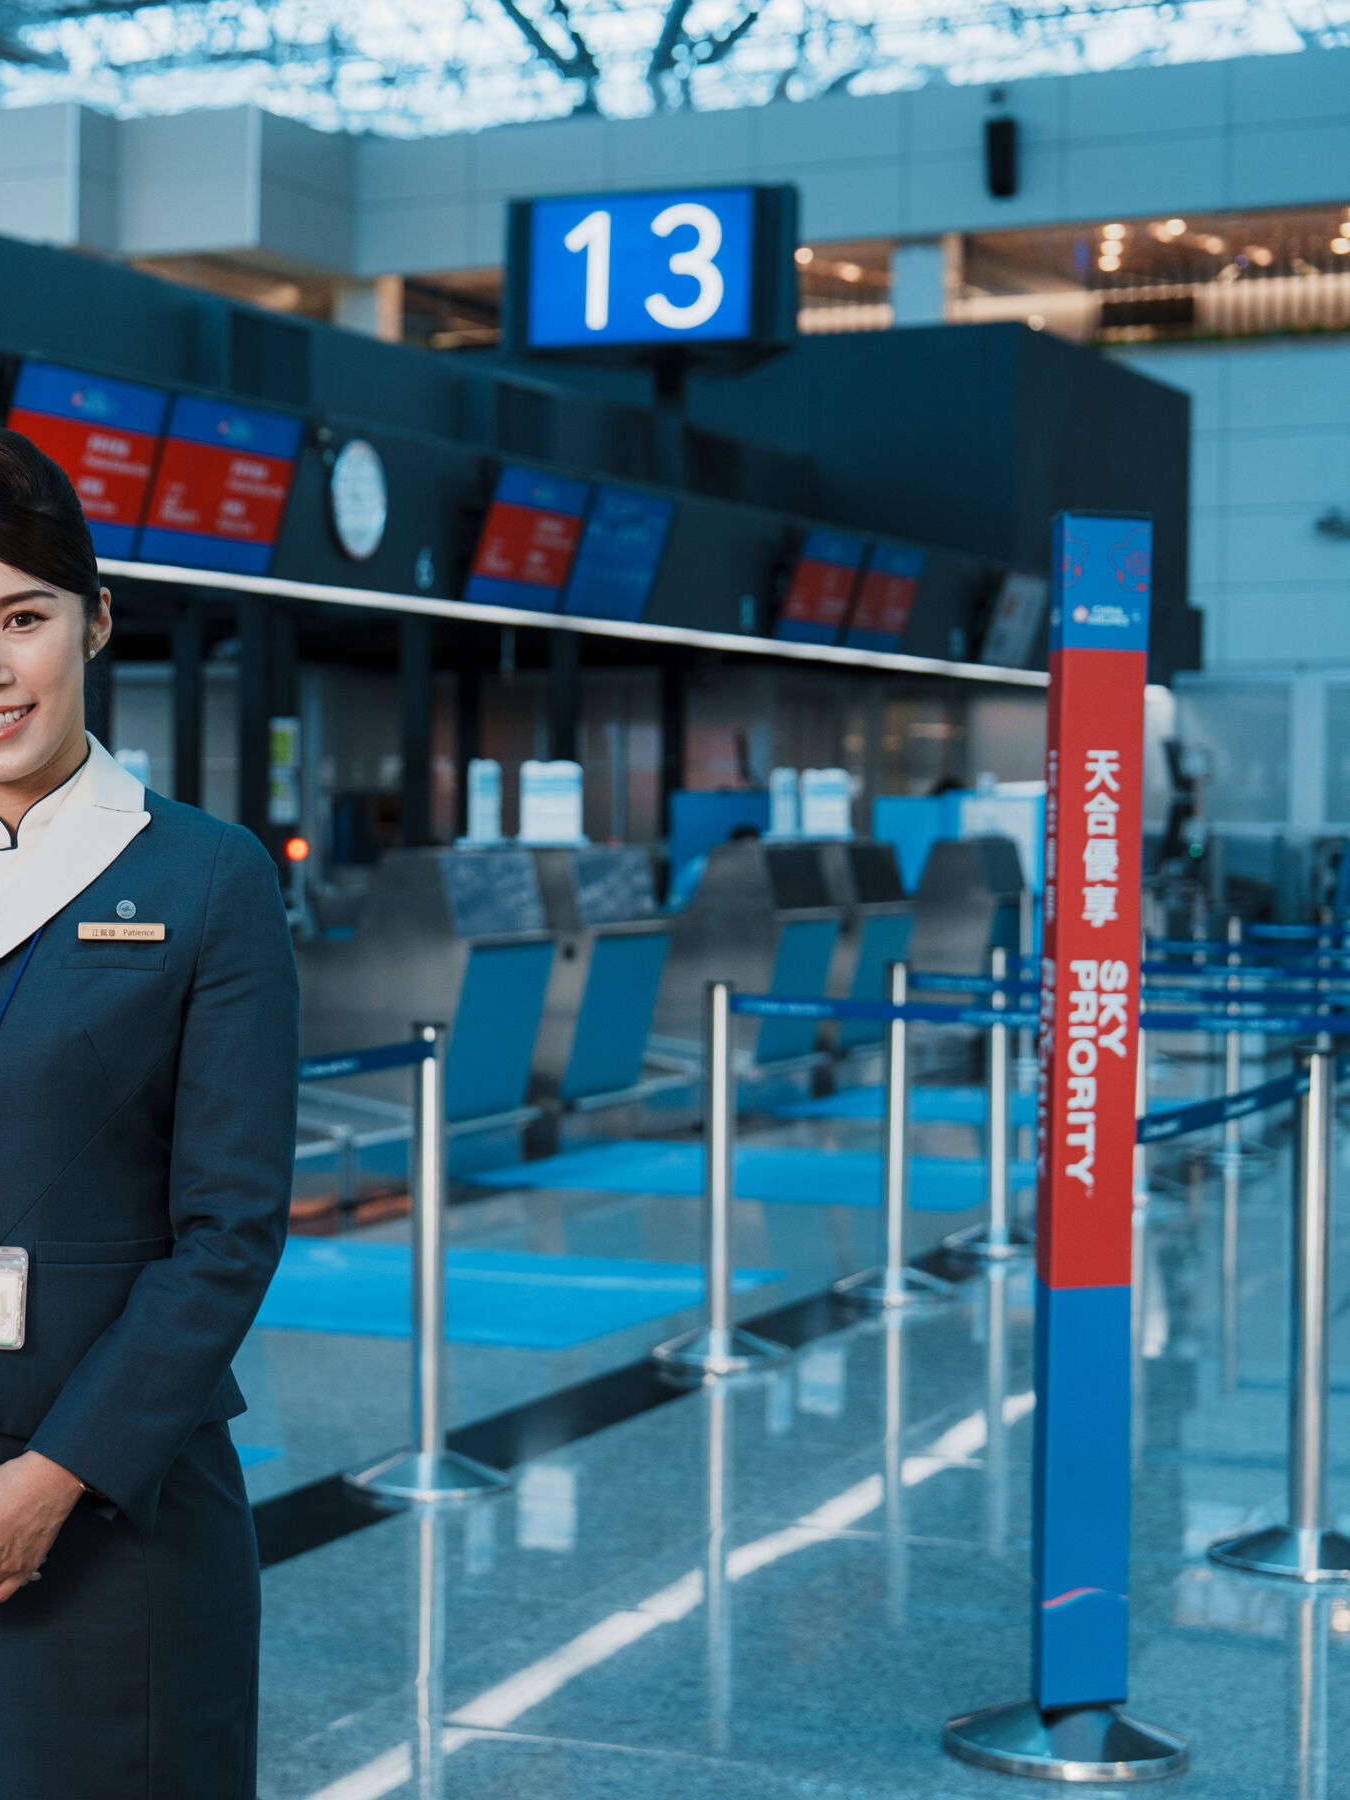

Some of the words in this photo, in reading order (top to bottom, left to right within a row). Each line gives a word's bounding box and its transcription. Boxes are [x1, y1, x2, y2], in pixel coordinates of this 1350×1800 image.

[563, 202, 725, 331] 13
[1081, 749, 1120, 928] 天合優享
[122, 928, 155, 937] Patience
[1065, 959, 1099, 1186] PRIORITY
[1098, 959, 1129, 1058] SKY
